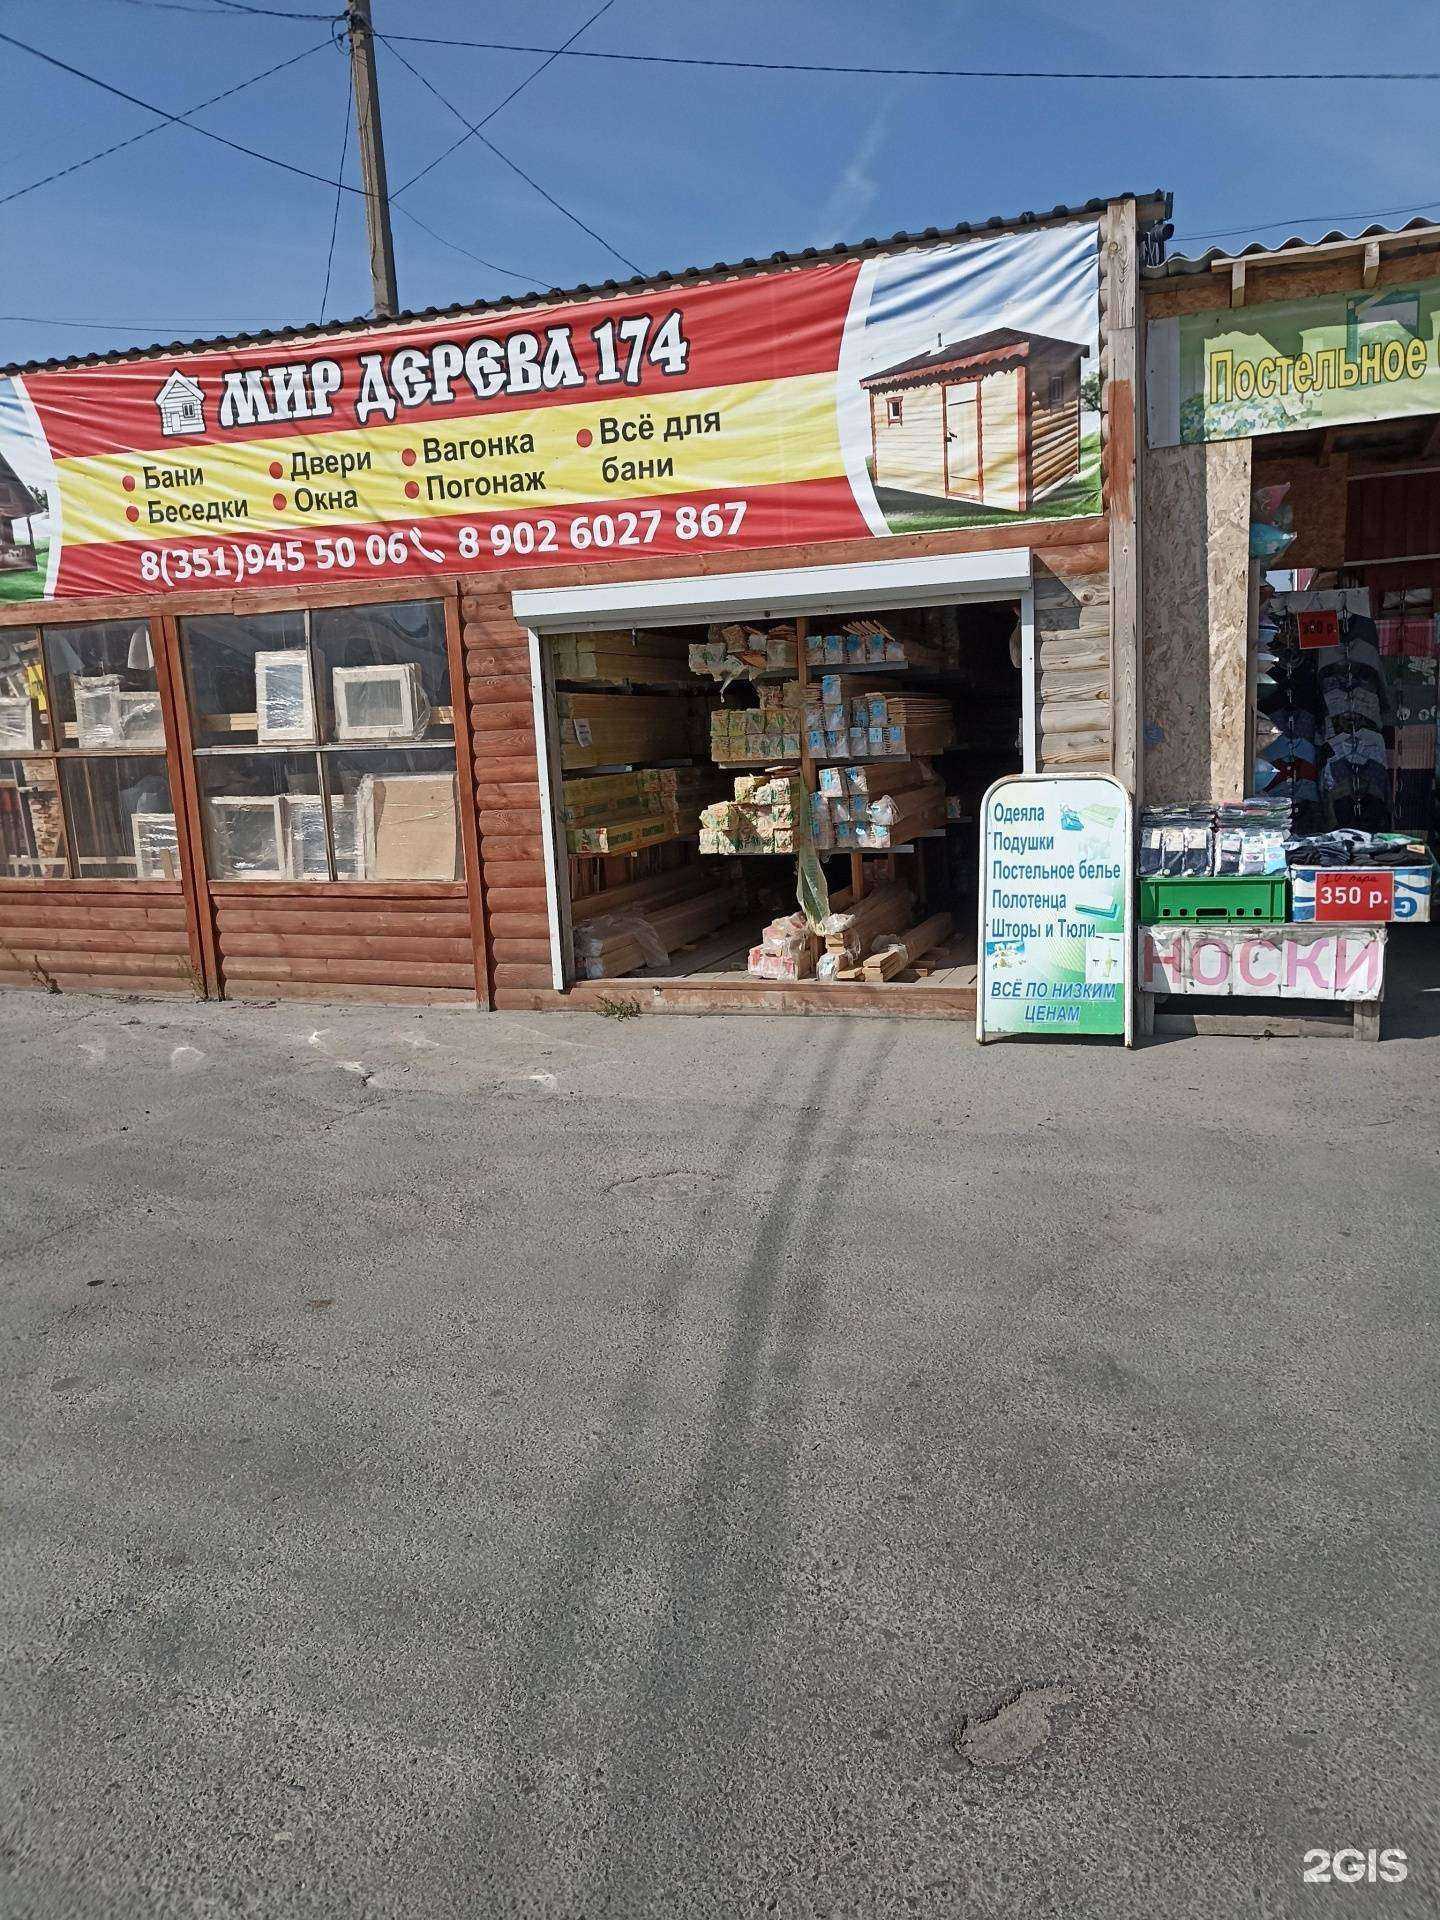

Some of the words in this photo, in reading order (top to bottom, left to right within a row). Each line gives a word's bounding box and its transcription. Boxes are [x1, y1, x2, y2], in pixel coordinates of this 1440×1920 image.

[219, 359, 343, 429] МИР
[591, 308, 690, 386] 174
[1209, 337, 1428, 404] Постельное
[599, 413, 654, 445] Всё
[662, 411, 721, 443] для
[423, 432, 535, 464] Вагонка
[142, 466, 204, 490] Бани
[289, 451, 372, 481] Двери
[601, 456, 674, 484] бани
[426, 469, 546, 501] Погонаж
[147, 498, 249, 524] Беседки
[294, 487, 359, 513] Окна
[457, 525, 480, 560] 8
[490, 519, 560, 557] 902
[569, 509, 662, 550] 6027
[675, 500, 749, 541] 867
[140, 541, 306, 587] 8(351)945
[315, 536, 357, 570] 50
[365, 531, 409, 565] 06
[994, 802, 1045, 824] Одеяла
[993, 831, 1054, 855] Подушки
[993, 860, 1075, 880] Постельное
[1078, 858, 1121, 880] белье
[992, 889, 1067, 911] Полотенца
[1320, 886, 1361, 905] 350
[1369, 890, 1388, 908] р.
[991, 918, 1041, 941] Шторы
[1045, 923, 1054, 938] и
[1057, 918, 1096, 939] Тюли
[1143, 936, 1380, 990] НОСКИ
[991, 977, 1022, 998] ВСЁ
[1025, 982, 1048, 998] ПО
[1052, 982, 1116, 999] НИЗКИМ
[1024, 1004, 1080, 1024] ЦЕНАМ
